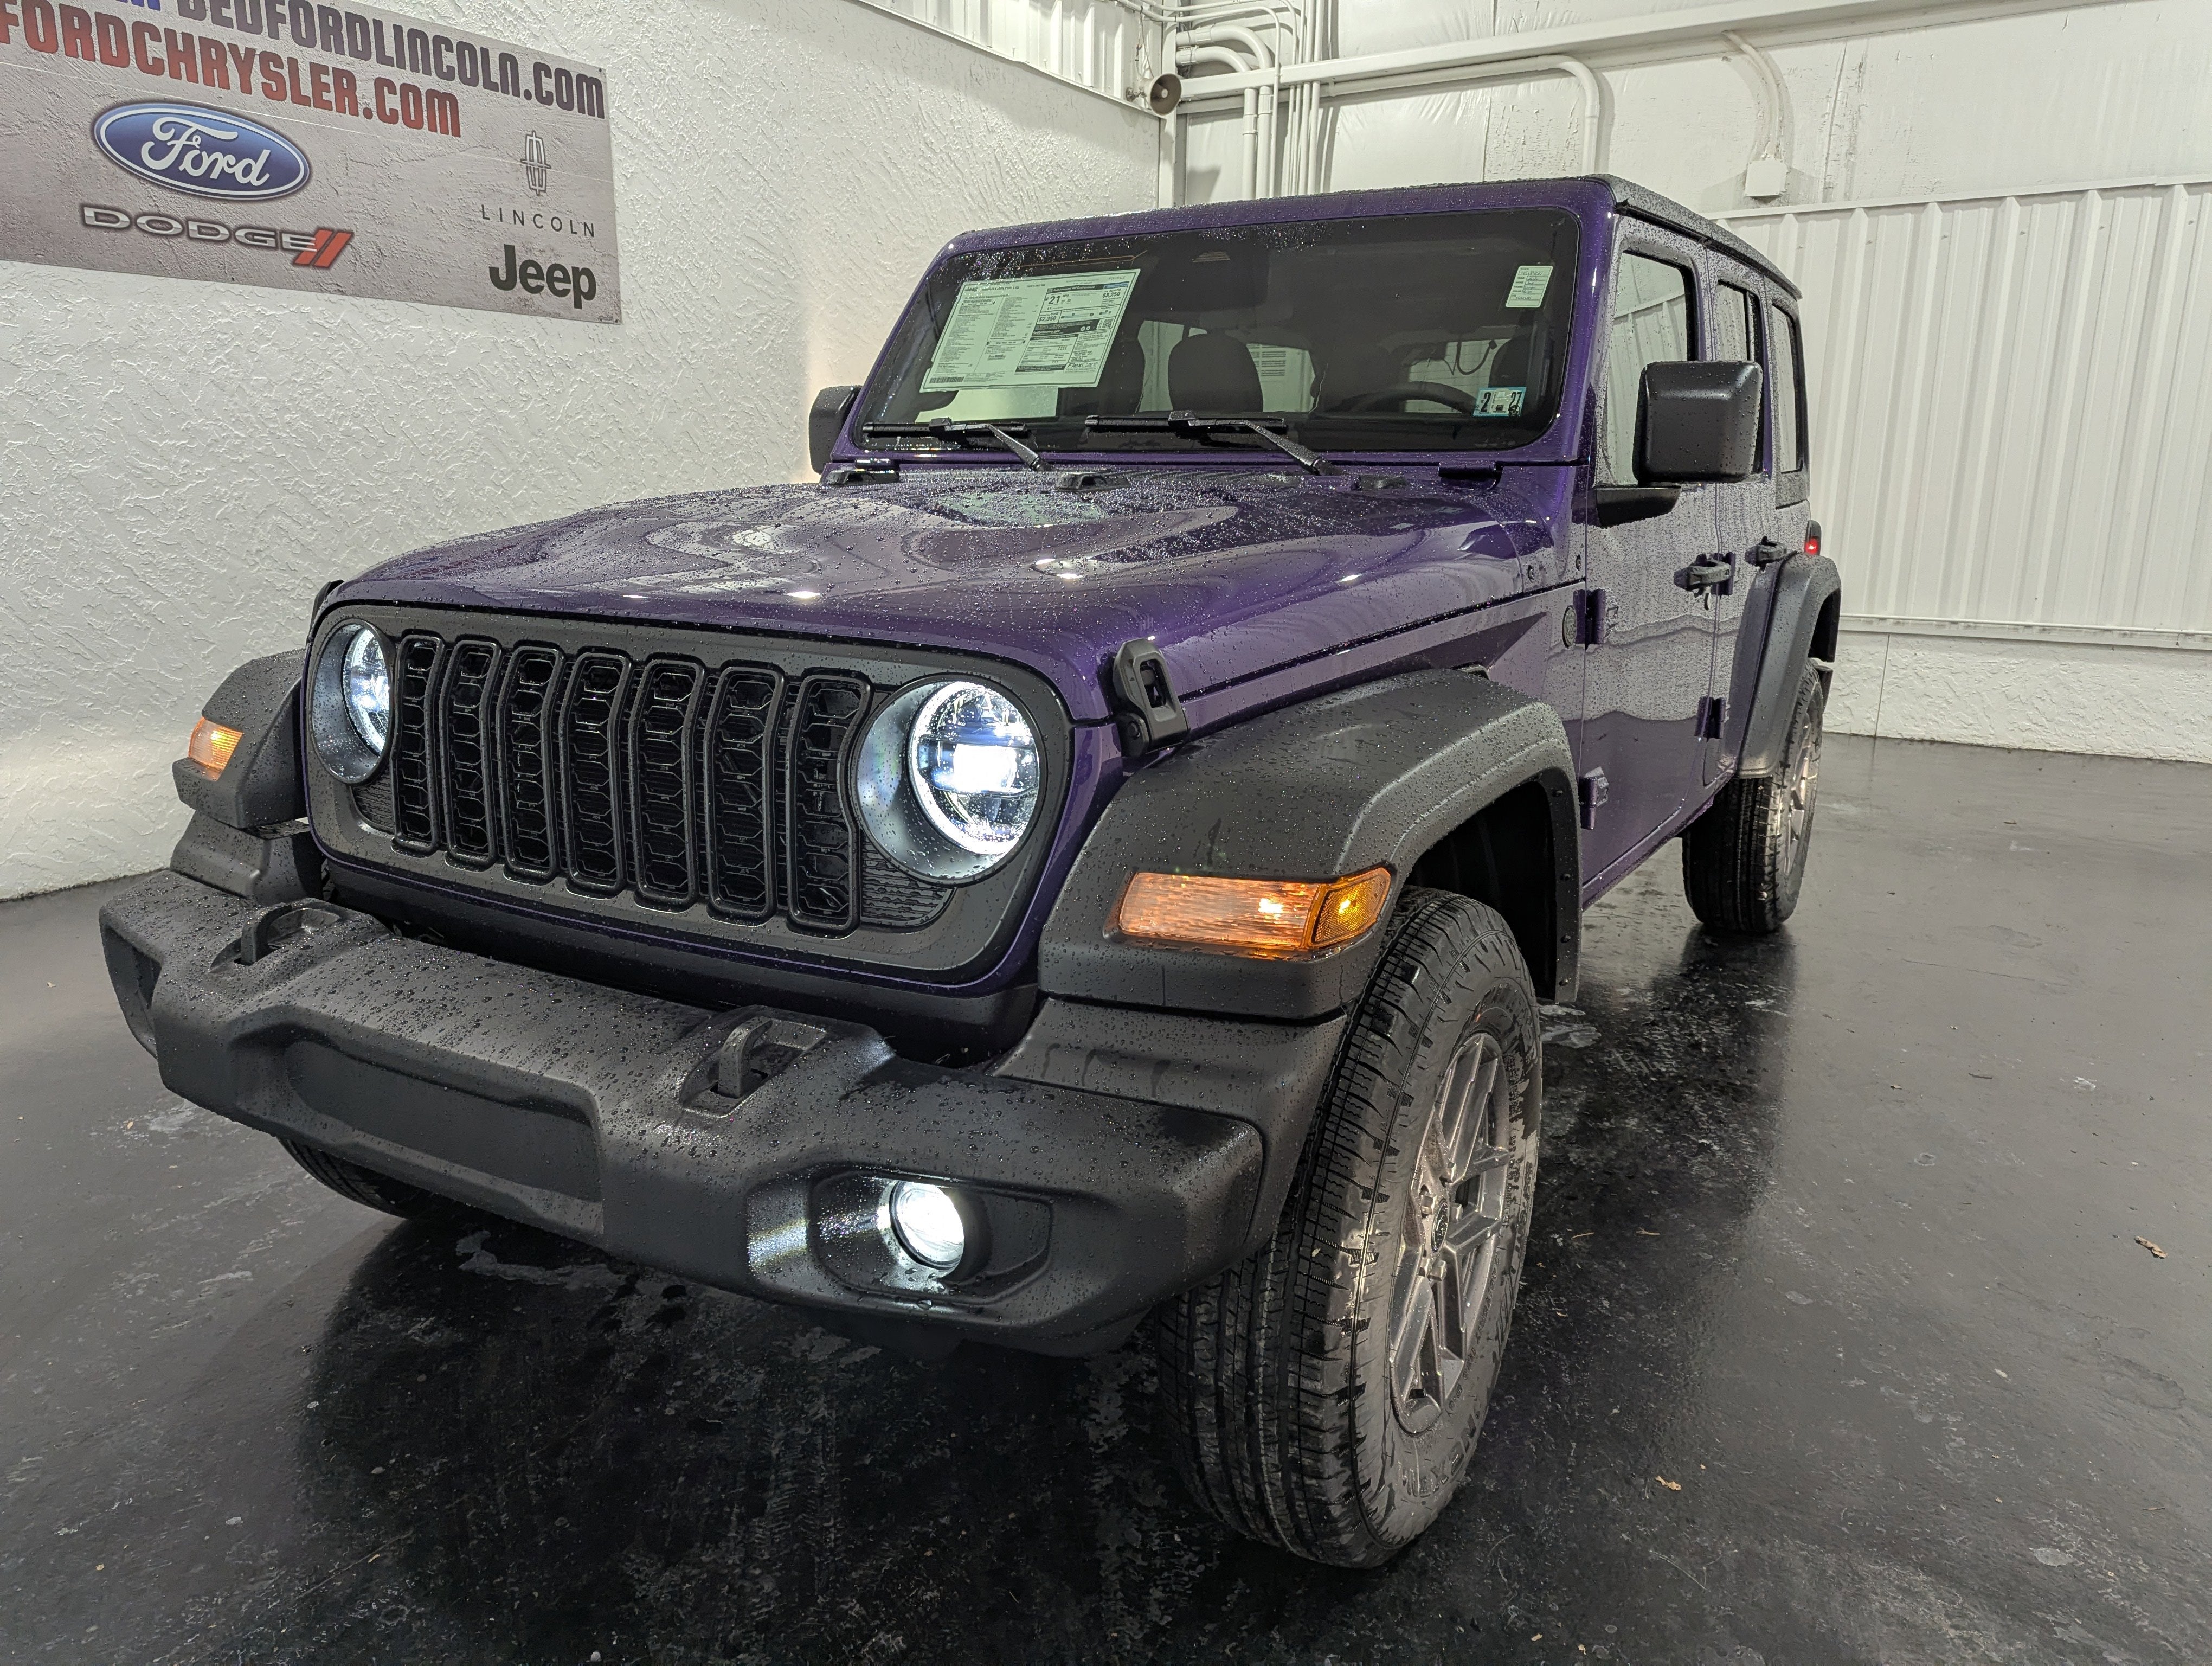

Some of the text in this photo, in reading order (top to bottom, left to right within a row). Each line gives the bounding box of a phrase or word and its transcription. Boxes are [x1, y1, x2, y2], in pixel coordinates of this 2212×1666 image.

[141, 117, 272, 186] Ford
[83, 207, 318, 252] DODGE
[481, 204, 595, 237] LINCOLN
[488, 244, 596, 310] Jeep
[1048, 295, 1060, 304] 21
[1480, 392, 1491, 412] 2
